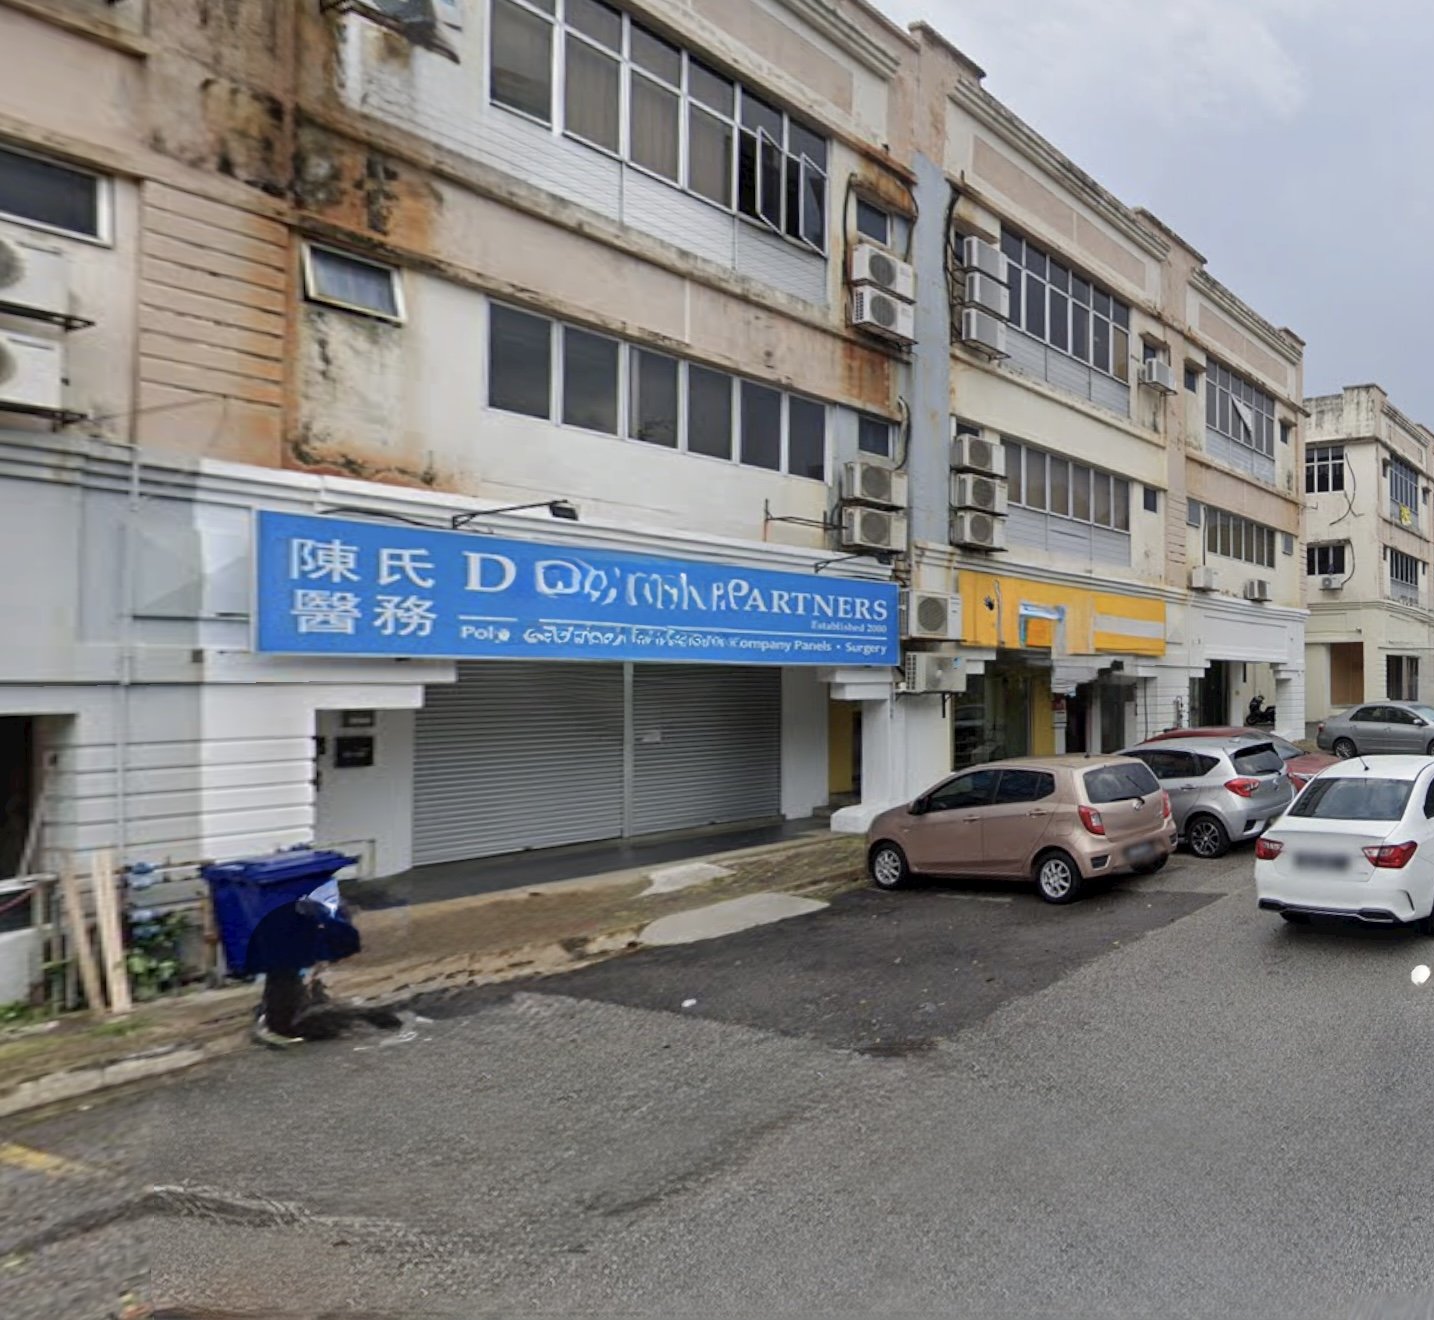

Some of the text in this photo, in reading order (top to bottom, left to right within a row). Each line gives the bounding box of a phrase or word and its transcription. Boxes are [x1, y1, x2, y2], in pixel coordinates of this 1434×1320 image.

[289, 537, 437, 589] 陳氏
[290, 588, 438, 637] 醫務
[728, 579, 888, 621] PARTNERS
[811, 620, 865, 632] Established
[794, 640, 832, 652] Panels
[845, 642, 887, 655] Surgery
